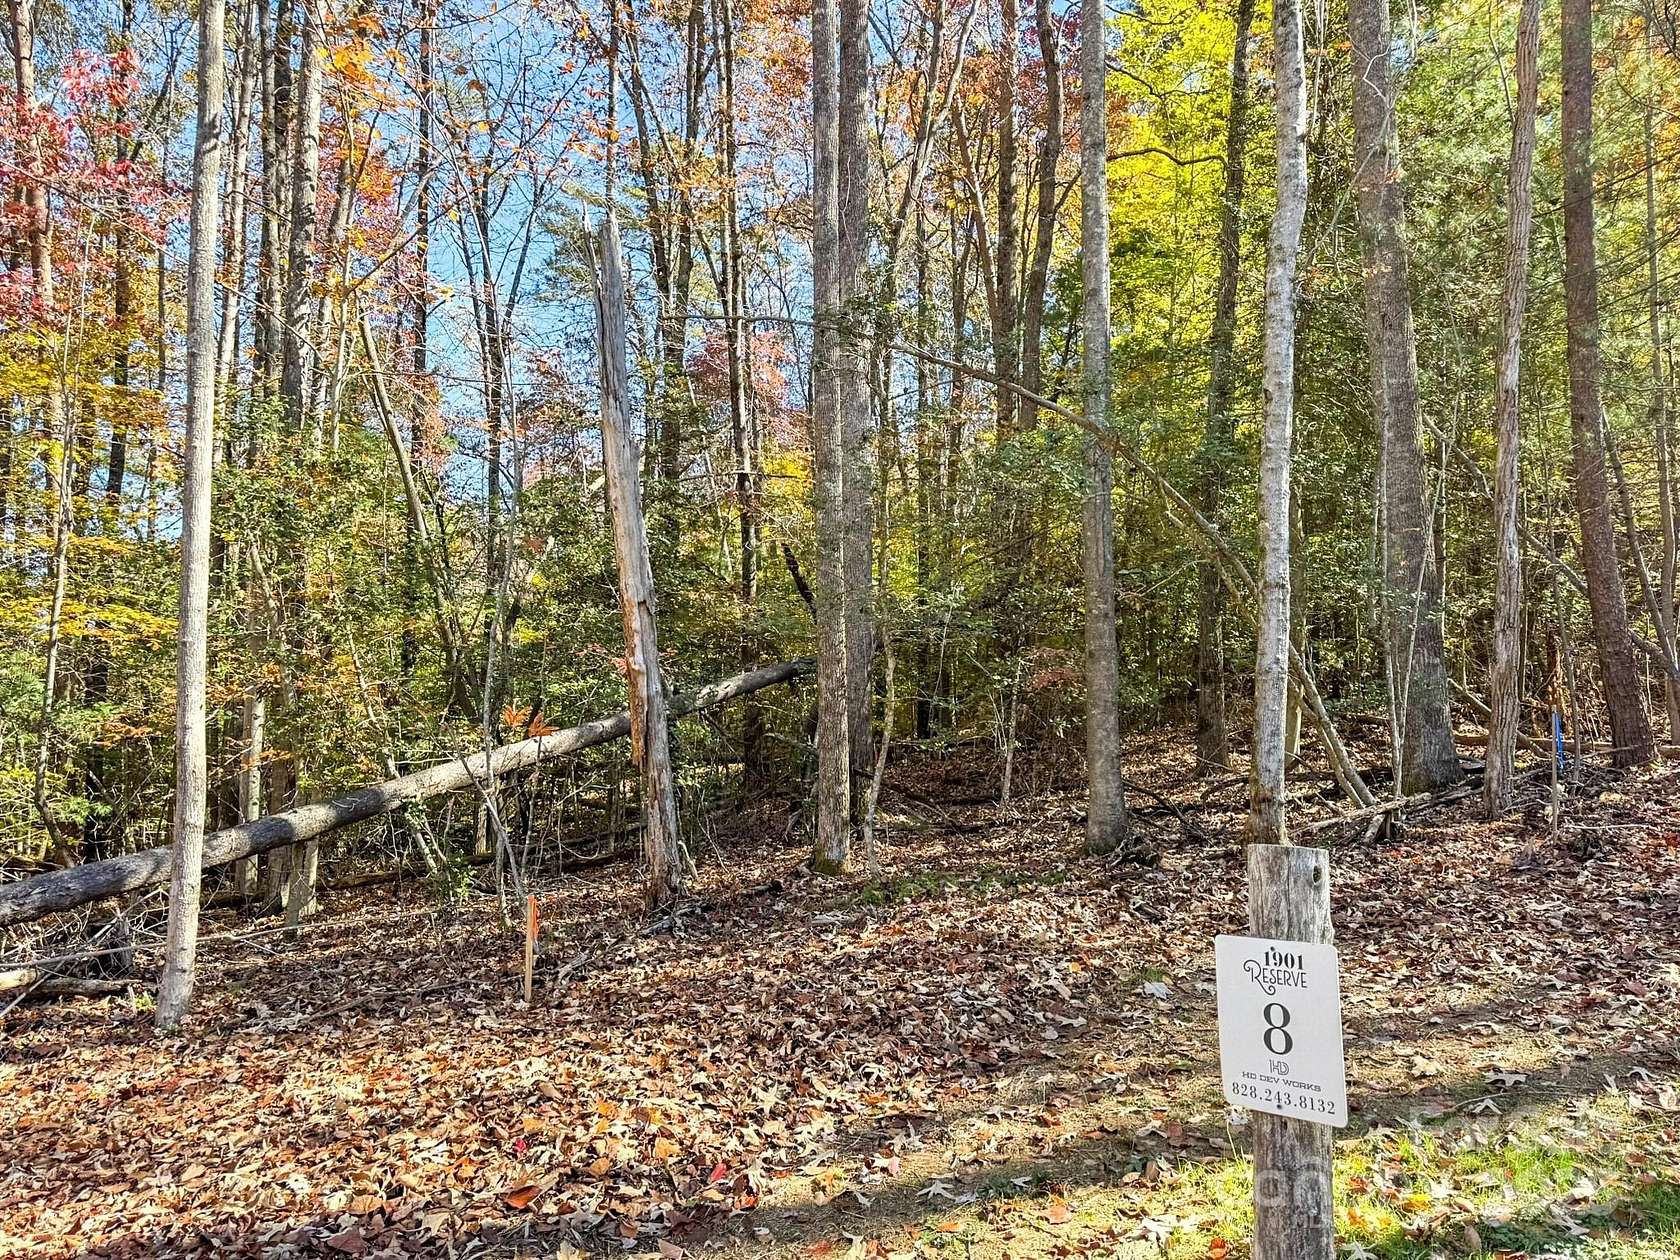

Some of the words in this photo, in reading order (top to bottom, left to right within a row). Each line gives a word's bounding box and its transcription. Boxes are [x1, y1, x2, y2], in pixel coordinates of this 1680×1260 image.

[1264, 951, 1304, 970] 1901
[1263, 1002, 1293, 1055] 8
[1242, 1071, 1257, 1080] HD
[1259, 1074, 1280, 1084] DEV
[1282, 1079, 1322, 1092] WORKS
[1232, 1081, 1336, 1115] 828.243.8132
